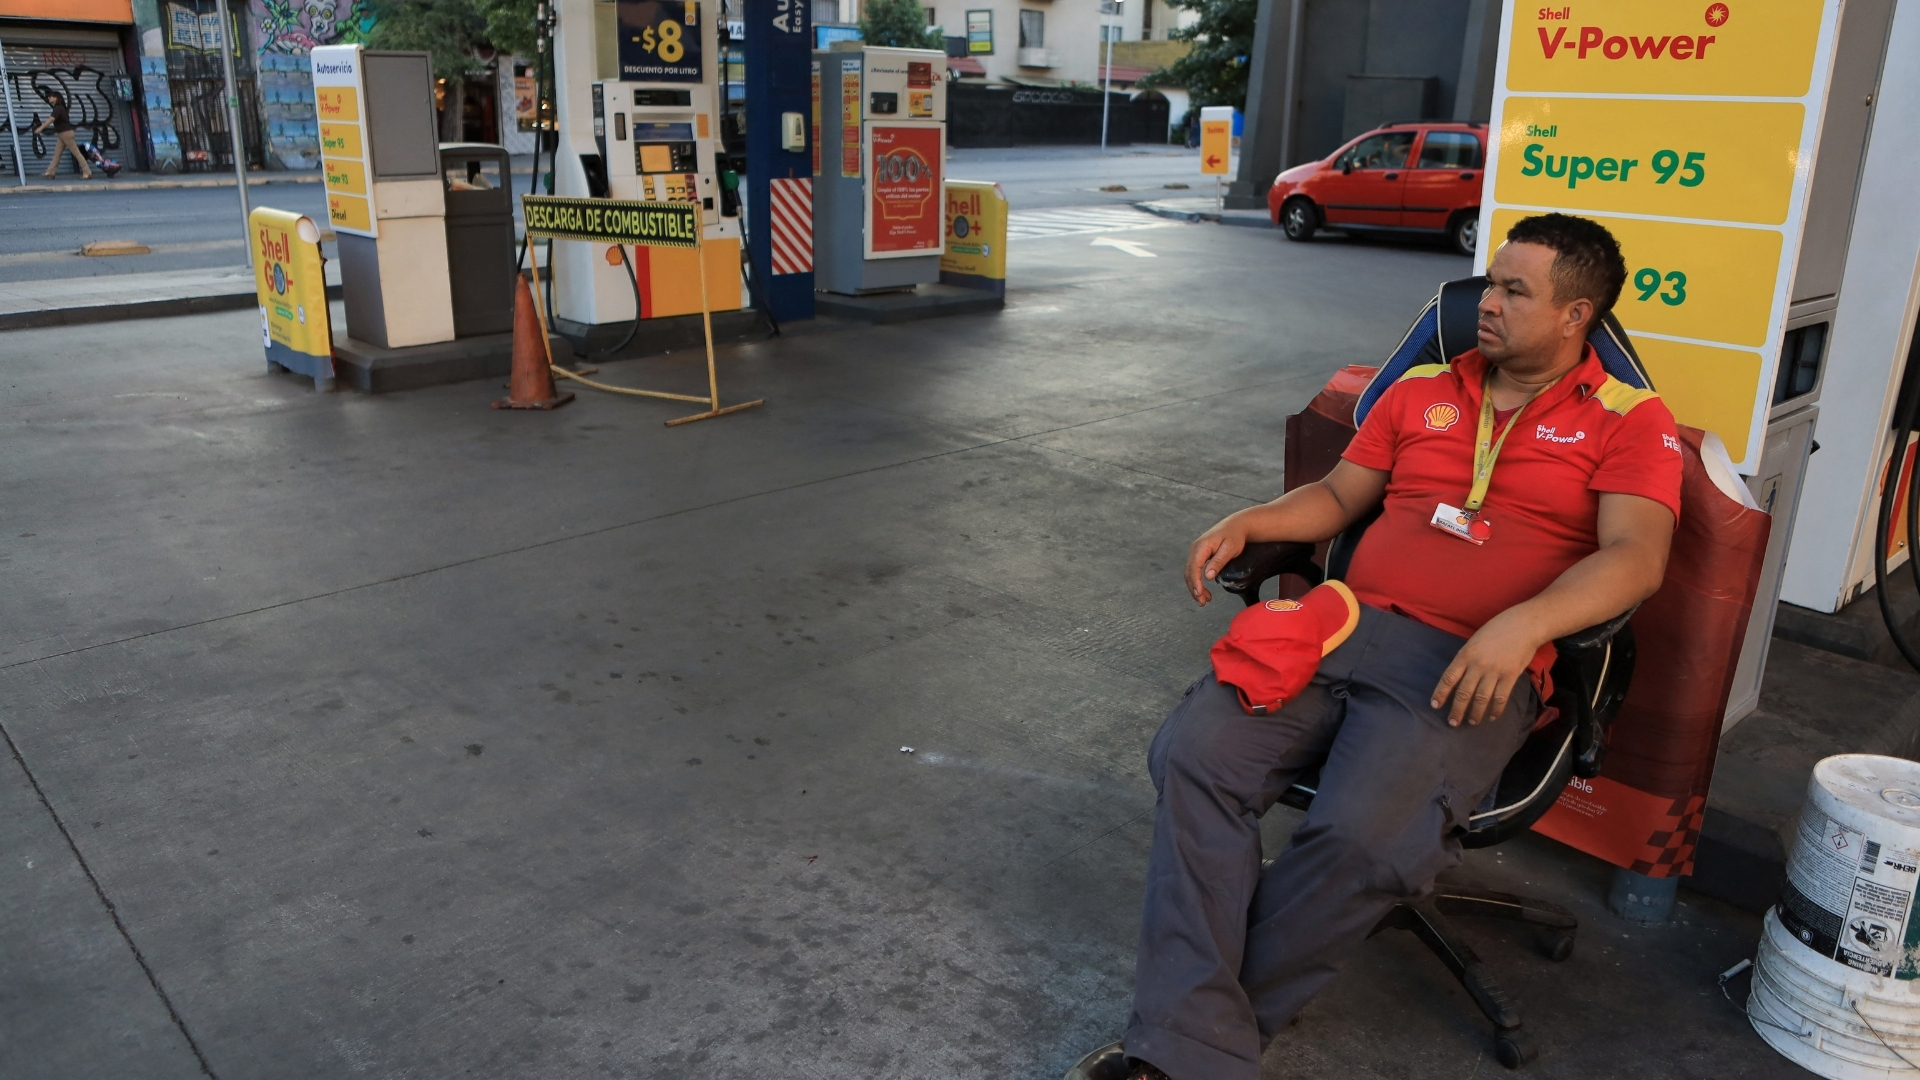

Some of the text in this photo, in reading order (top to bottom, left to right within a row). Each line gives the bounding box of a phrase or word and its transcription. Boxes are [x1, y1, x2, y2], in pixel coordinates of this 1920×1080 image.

[793, 0, 804, 33] Easy
[1538, 7, 1570, 20] Shell
[1537, 26, 1715, 60] V-Power
[316, 61, 353, 75] Autoservicio
[624, 65, 698, 75] DESCUENTO POR LITRO
[320, 103, 340, 114] V-Power
[1526, 125, 1557, 138] Shell
[323, 137, 345, 150] Super 95
[876, 154, 933, 183] 100%
[1521, 143, 1706, 189] Super 95
[327, 172, 349, 186] Super 93
[945, 192, 980, 216] hell
[331, 208, 347, 220] Diesel
[525, 205, 694, 239] DESCARGA DE COMBUSTIBLE
[260, 228, 290, 264] Shell
[1634, 267, 1687, 306] 93
[1537, 424, 1556, 434] Shell
[1536, 431, 1579, 444] V-Power
[1663, 439, 1681, 452] HE
[1568, 775, 1593, 794] ible
[1893, 861, 1917, 874] BEHR
[1847, 958, 1878, 974] WNING
